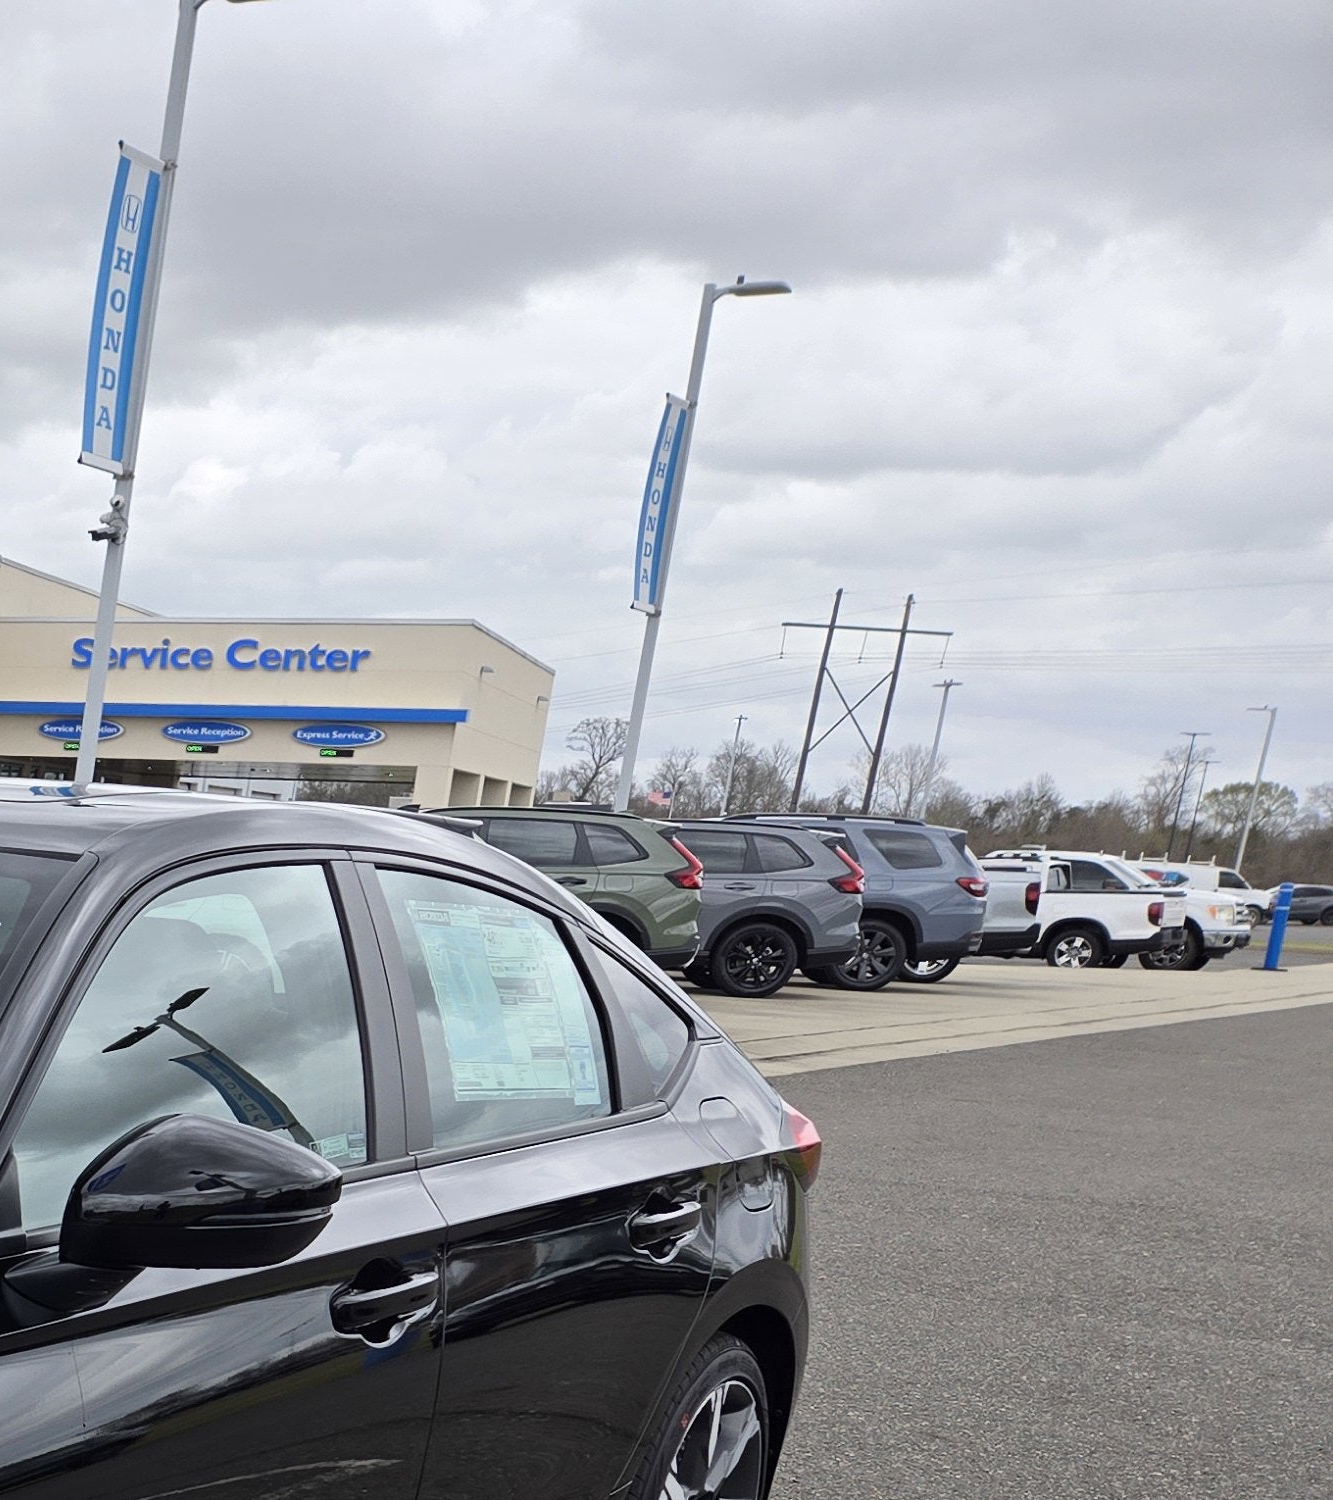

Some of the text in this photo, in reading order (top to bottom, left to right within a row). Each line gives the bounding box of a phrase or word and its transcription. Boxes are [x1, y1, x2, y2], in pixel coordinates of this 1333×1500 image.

[96, 246, 134, 430] HONDA
[640, 461, 667, 584] HONDA
[226, 638, 371, 671] Center
[44, 724, 74, 733] Service
[167, 726, 245, 738] Service Reception
[296, 730, 365, 741] Express Service
